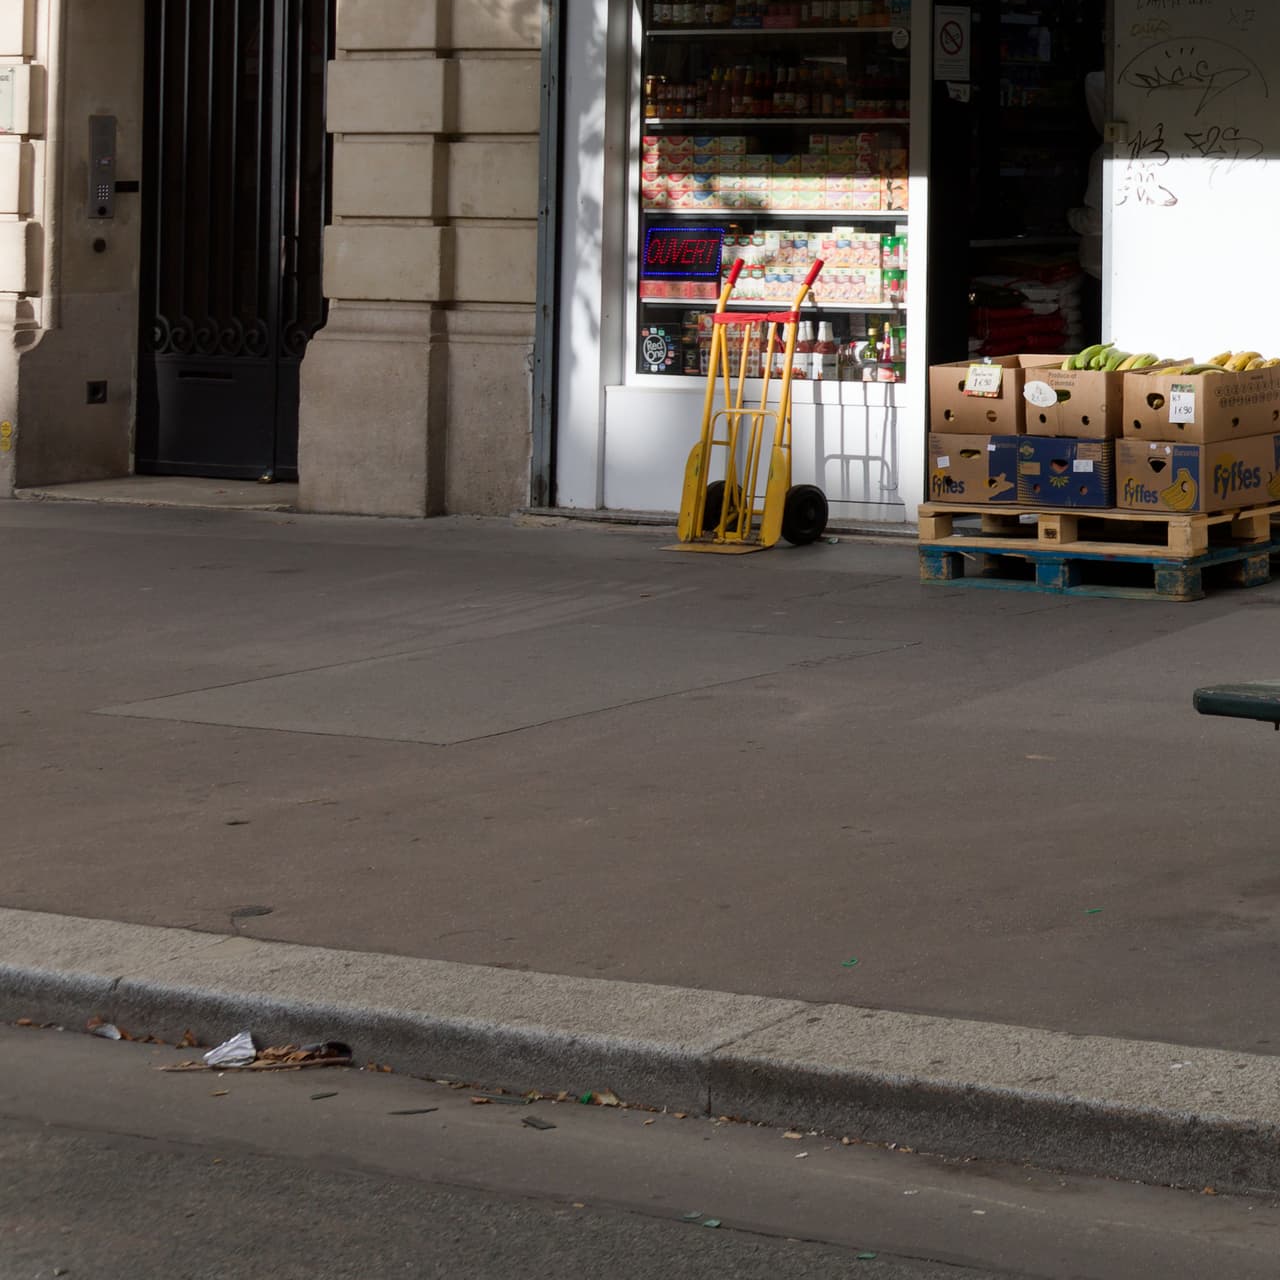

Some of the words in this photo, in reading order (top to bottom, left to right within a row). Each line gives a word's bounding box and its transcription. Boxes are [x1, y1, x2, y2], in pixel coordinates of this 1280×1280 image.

[647, 238, 719, 265] OUVERT
[646, 340, 664, 352] Red
[646, 349, 664, 361] One
[1174, 405, 1193, 415] 1€90
[1213, 460, 1262, 500] fyffes
[1124, 478, 1159, 506] fyffes
